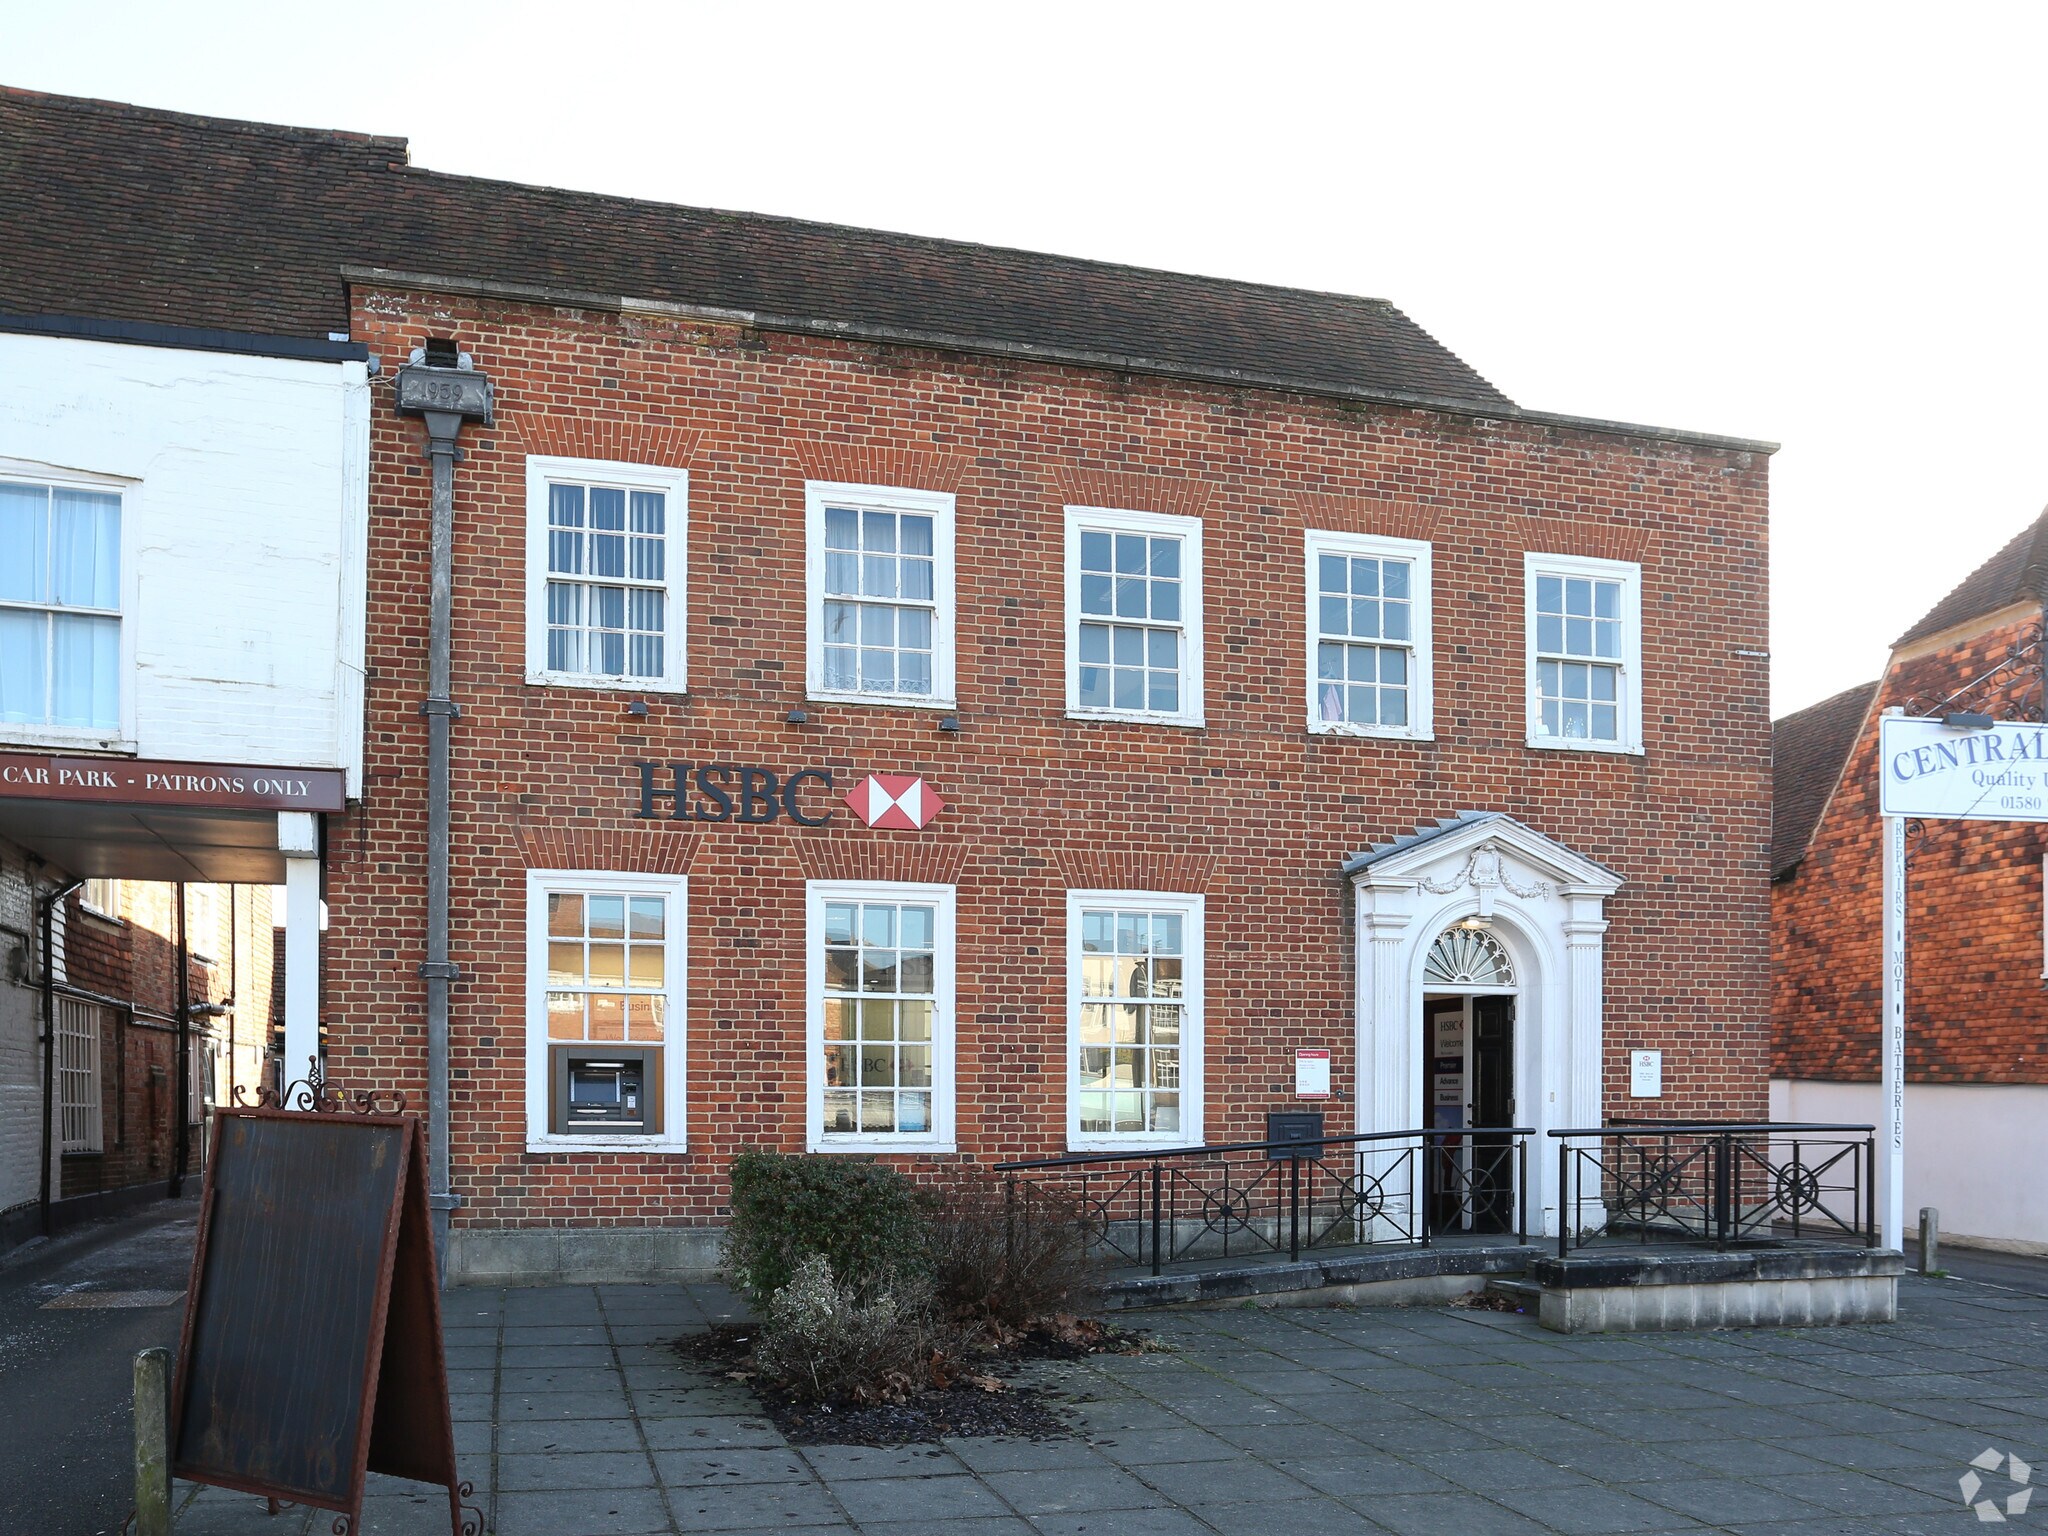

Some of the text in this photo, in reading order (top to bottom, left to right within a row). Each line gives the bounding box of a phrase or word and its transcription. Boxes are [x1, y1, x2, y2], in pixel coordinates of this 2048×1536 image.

[1893, 732, 2048, 781] CENTRAL
[2, 765, 50, 785] CAR
[58, 768, 118, 788] PARK
[145, 773, 245, 794] PATRONS
[252, 778, 312, 797] ONLY
[1971, 769, 2036, 791] Quality
[633, 762, 834, 827] HSBC
[2000, 796, 2042, 810] 01580
[1893, 822, 1904, 1149] REPAIRS MOT BATTERIES
[619, 1000, 663, 1013] Busins
[1440, 1020, 1459, 1032] HSBC
[1440, 1077, 1459, 1085] Advance
[1440, 1093, 1459, 1102] Business
